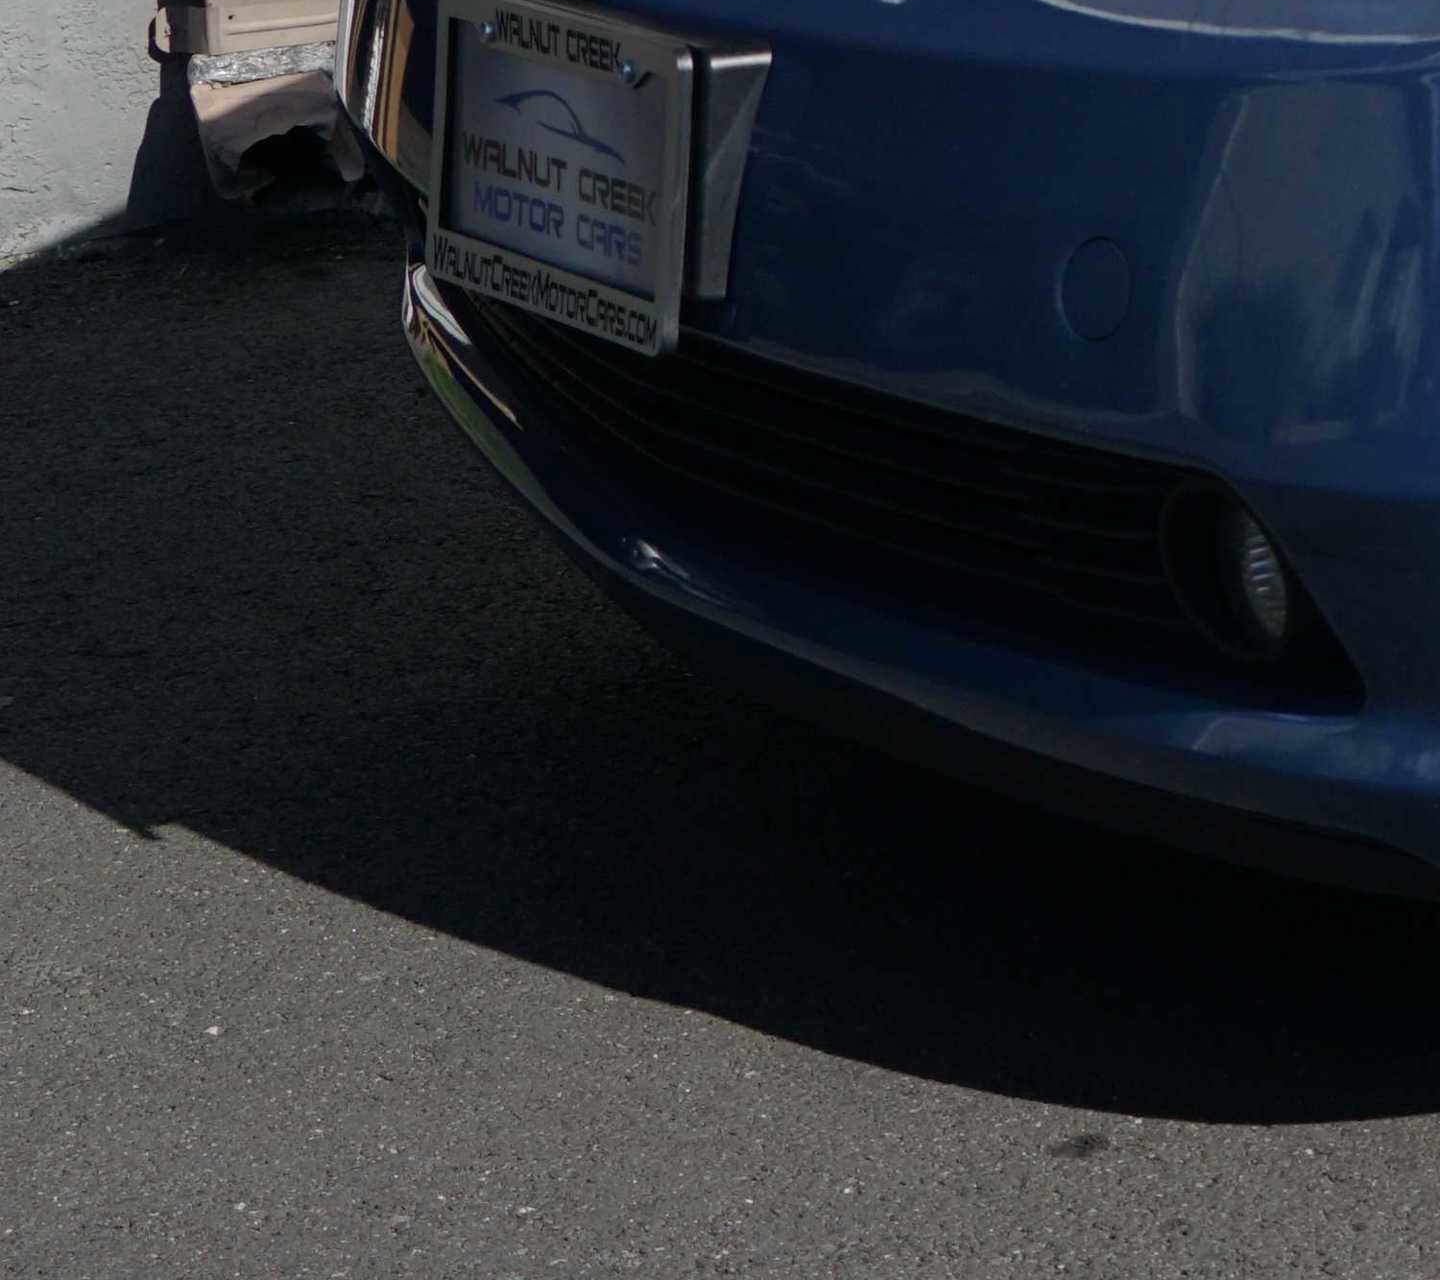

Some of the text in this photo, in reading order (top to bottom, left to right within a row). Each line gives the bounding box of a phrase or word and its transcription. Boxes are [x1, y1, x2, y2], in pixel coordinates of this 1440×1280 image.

[496, 8, 623, 74] WALNUT CREEK
[462, 130, 660, 226] WALNUT CREEK
[473, 180, 643, 266] MOTOR CARS
